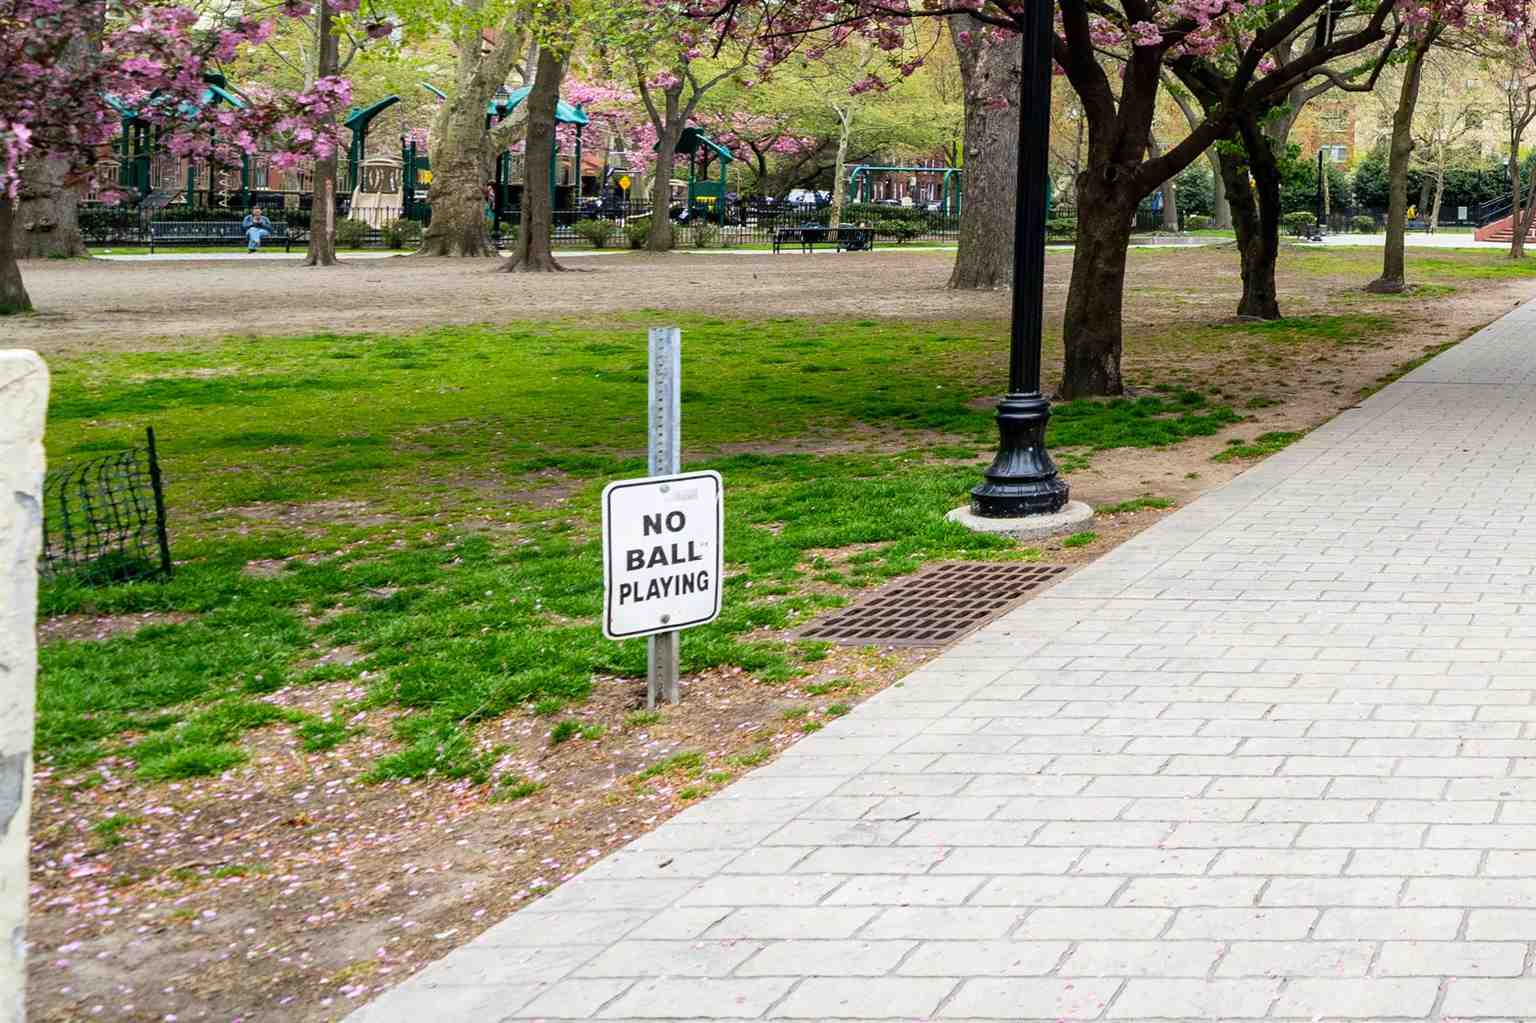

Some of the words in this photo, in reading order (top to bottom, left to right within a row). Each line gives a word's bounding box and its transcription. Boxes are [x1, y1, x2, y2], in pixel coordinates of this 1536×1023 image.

[643, 510, 686, 536] NO
[626, 541, 702, 571] BALL
[619, 570, 709, 605] PLAYING
